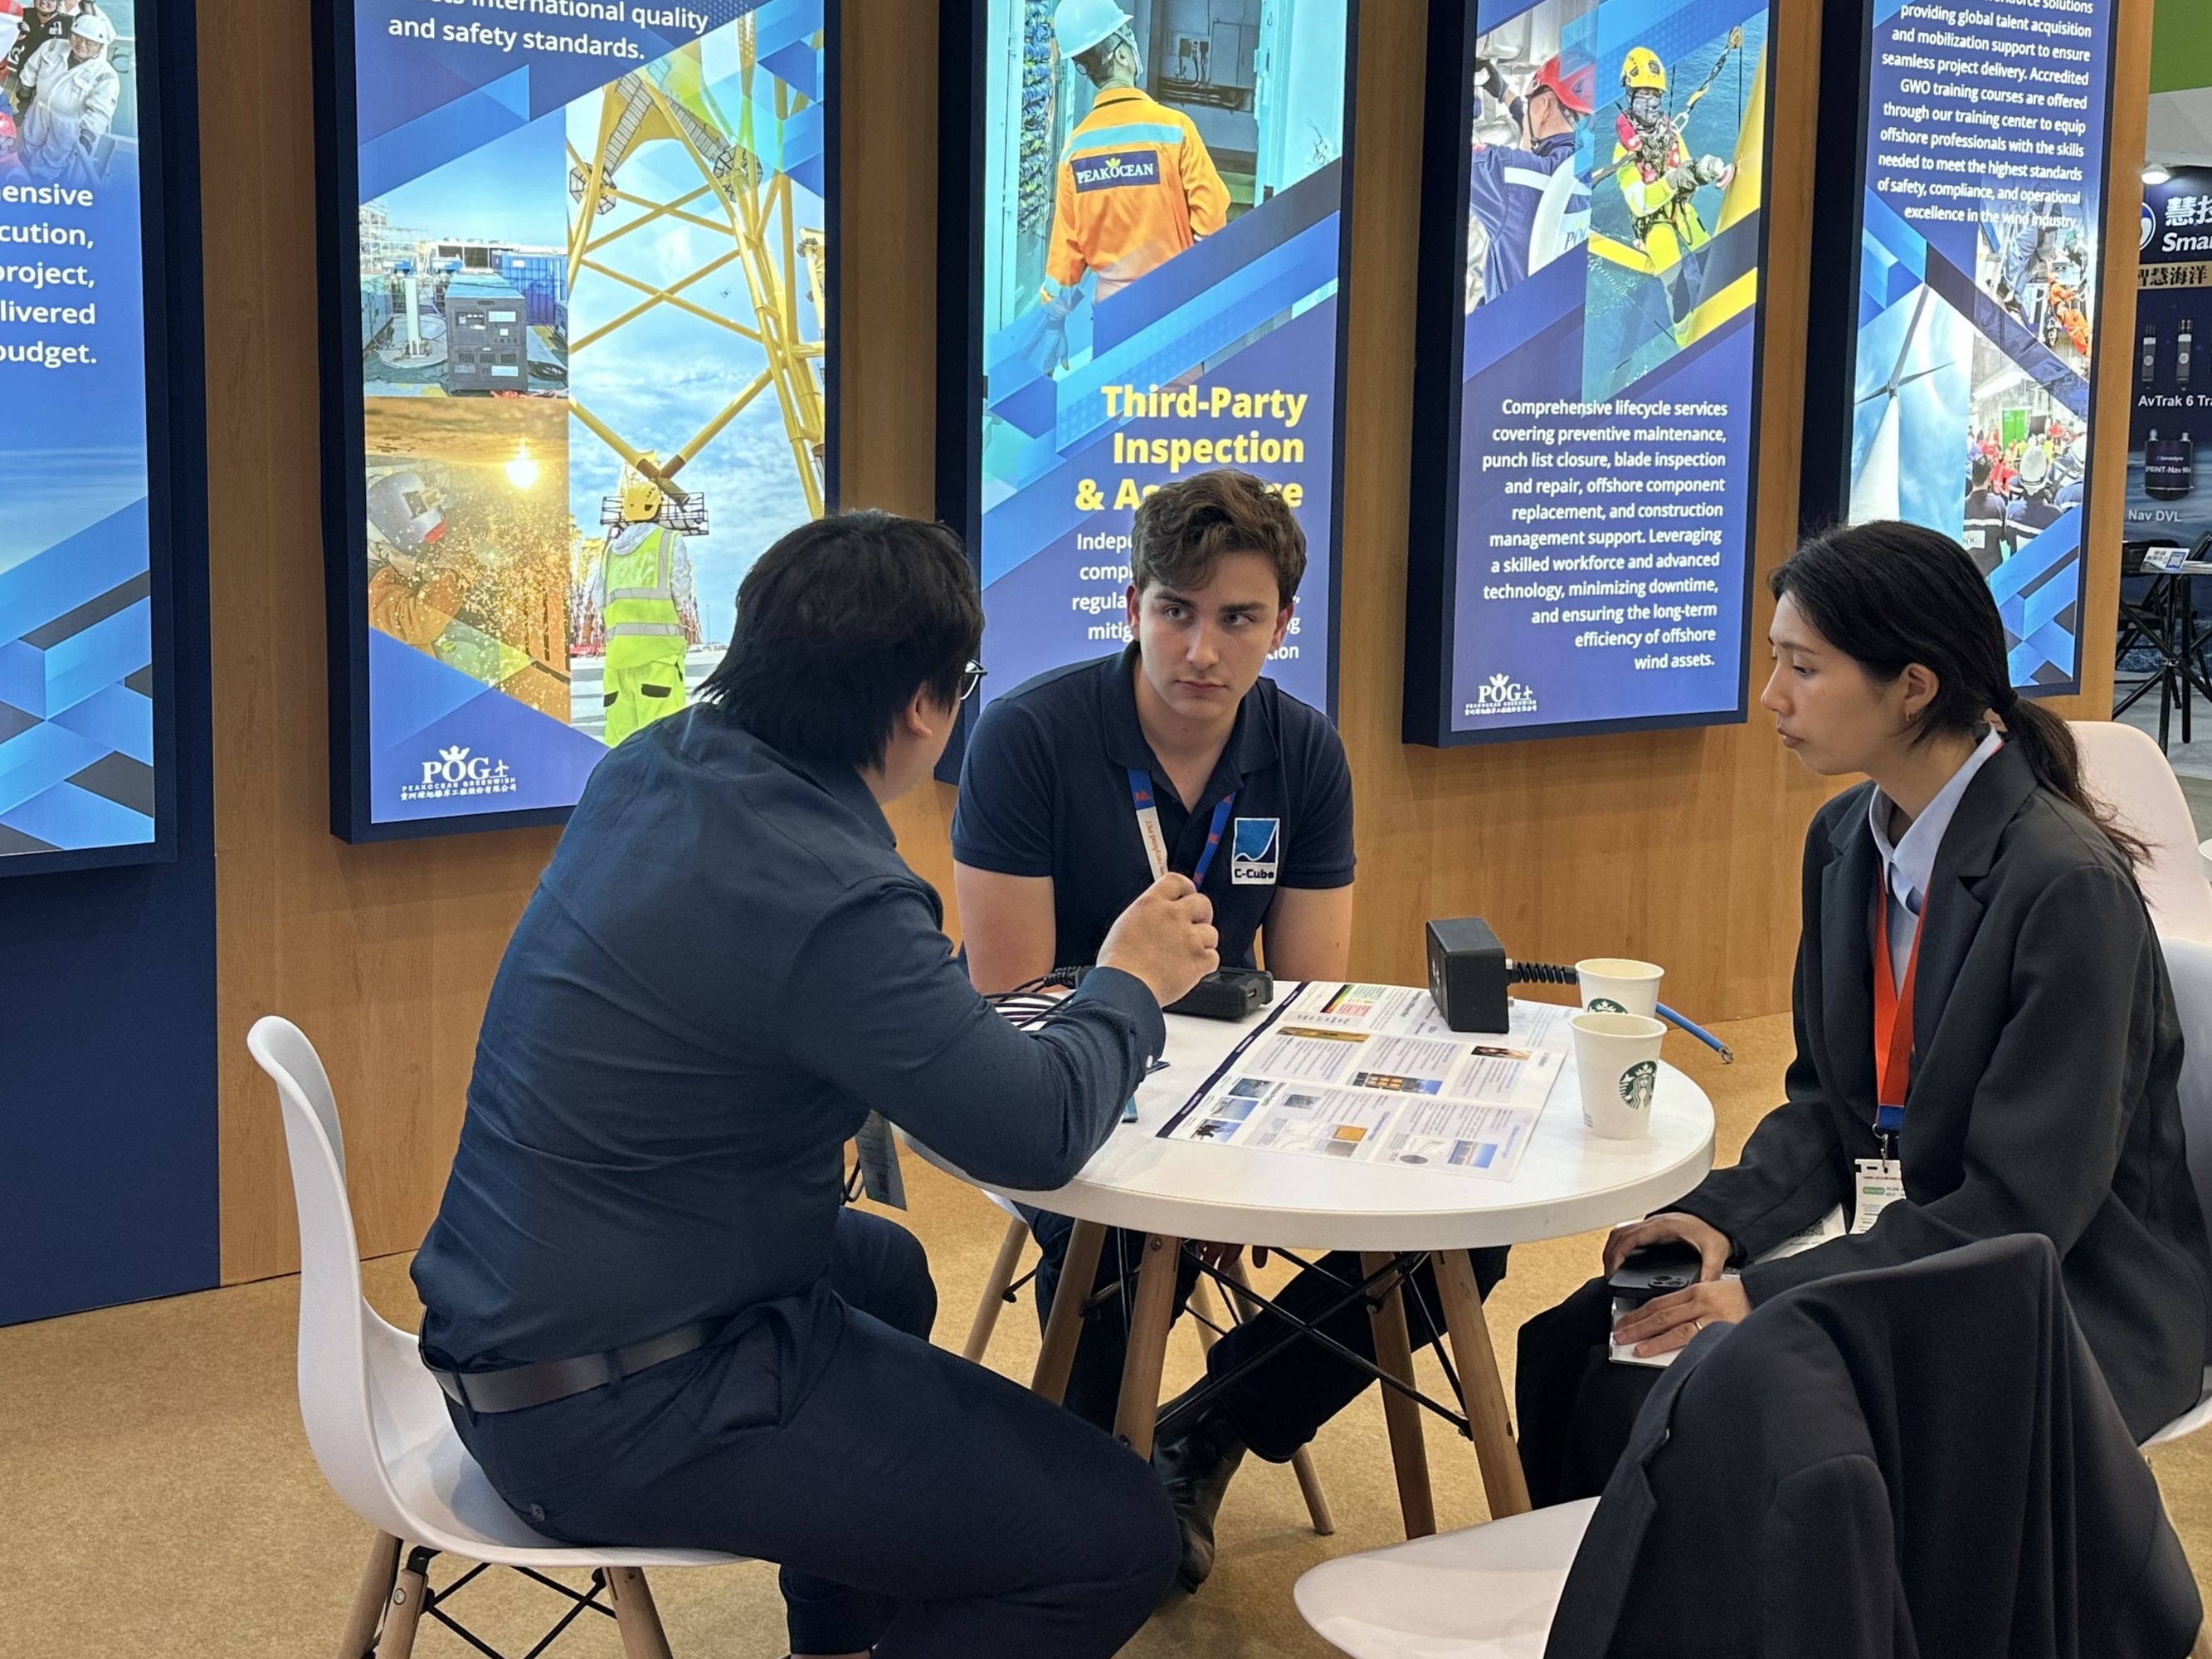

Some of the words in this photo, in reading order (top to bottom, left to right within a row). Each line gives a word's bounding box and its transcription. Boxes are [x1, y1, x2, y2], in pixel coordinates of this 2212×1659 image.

[2043, 0, 2093, 13] solutions
[632, 7, 709, 34] quality
[1901, 4, 1956, 25] providing
[1957, 9, 1994, 27] global
[1996, 14, 2029, 31] talent
[2031, 21, 2092, 37] acquisition
[389, 18, 435, 38] and
[443, 22, 517, 52] safety
[524, 32, 645, 59] standards.
[1892, 27, 1915, 41] and
[1917, 31, 1989, 51] mobilization
[1992, 41, 2035, 57] support
[2038, 44, 2049, 57] to
[2052, 47, 2090, 61] ensure
[1882, 53, 1935, 70] seamless
[1937, 59, 1979, 76] project
[1981, 61, 2027, 82] delivery.
[2029, 67, 2089, 85] Accredited
[1901, 79, 1931, 94] GWO
[1933, 83, 1979, 103] training
[1981, 89, 2024, 104] courses
[2026, 94, 2044, 105] are
[2047, 93, 2088, 110] offered
[1883, 101, 1929, 122] through
[1932, 110, 1953, 121] our
[1956, 110, 2000, 129] training
[2002, 116, 2038, 129] center
[2040, 118, 2052, 130] to
[2054, 119, 2086, 137] equip
[1880, 127, 1928, 144] offshore
[1931, 133, 2006, 151] professionals
[2009, 139, 2034, 153] with
[2036, 140, 2054, 154] the
[2057, 142, 2084, 157] skills
[1076, 163, 1154, 184] PEAKOCEAN
[1878, 154, 1920, 168] needed
[1922, 157, 1934, 169] to
[1937, 159, 1966, 172] meet
[1967, 159, 1986, 173] the
[1988, 160, 2028, 178] highest
[2029, 165, 2083, 181] standards
[0, 183, 93, 207] ensive
[1878, 177, 1890, 191] of
[1891, 178, 1927, 198] safety,
[1929, 183, 1995, 199] compliance,
[1998, 187, 2018, 200] and
[2020, 189, 2081, 205] operational
[1904, 205, 1965, 222] excellence
[1967, 207, 1978, 222] in
[1981, 207, 2000, 222] the
[2002, 210, 2029, 225] wind
[2032, 212, 2077, 228] industry.
[1564, 225, 1590, 251] PO
[1, 300, 95, 324] livered
[1101, 384, 1308, 428] Third-Party
[1502, 398, 1613, 418] Comprehensive
[1615, 400, 1671, 419] lifecycle
[1674, 401, 1727, 416] services
[2138, 395, 2182, 407] AvTrak
[2185, 395, 2194, 407] 6
[1493, 426, 1555, 445] covering
[1558, 426, 1630, 445] preventive
[1634, 426, 1726, 442] maintenance,
[1113, 431, 1304, 474] Inspection
[1483, 451, 1527, 471] punch
[1532, 452, 1554, 467] list
[1557, 451, 1611, 469] closure,
[1615, 451, 1652, 466] blade
[1655, 451, 1725, 471] inspection
[1074, 478, 1105, 511] &
[1505, 478, 1532, 494] and
[1537, 478, 1583, 497] repair,
[1586, 477, 1643, 493] offshore
[1646, 479, 1726, 495] component
[1513, 504, 1605, 524] replacement,
[1610, 503, 1635, 518] and
[1638, 502, 1723, 518] construction
[2128, 510, 2152, 520] Nav
[2156, 510, 2182, 522] DVL
[1490, 531, 1586, 549] management
[1588, 530, 1646, 548] support.
[1649, 527, 1722, 545] Leveraging
[1491, 561, 1499, 573] a
[1503, 556, 1549, 573] skilled
[1552, 555, 1625, 571] workforce
[1628, 554, 1653, 568] and
[1656, 552, 1720, 568] advanced
[1484, 582, 1565, 601] technology,
[1569, 580, 1646, 598] minimizing
[1649, 578, 1718, 593] downtime,
[1532, 607, 1558, 623] and
[1562, 606, 1625, 624] ensuring
[1627, 604, 1650, 619] the
[1654, 603, 1717, 622] long-term
[1575, 631, 1643, 648] efficiency
[1644, 628, 1660, 644] of
[1662, 627, 1716, 643] offshore
[1635, 653, 1668, 670] wind
[1671, 653, 1714, 667] assets.
[421, 757, 491, 783] POG
[402, 782, 459, 793] PEAKOCEAN
[1235, 868, 1274, 879] C-Cube
